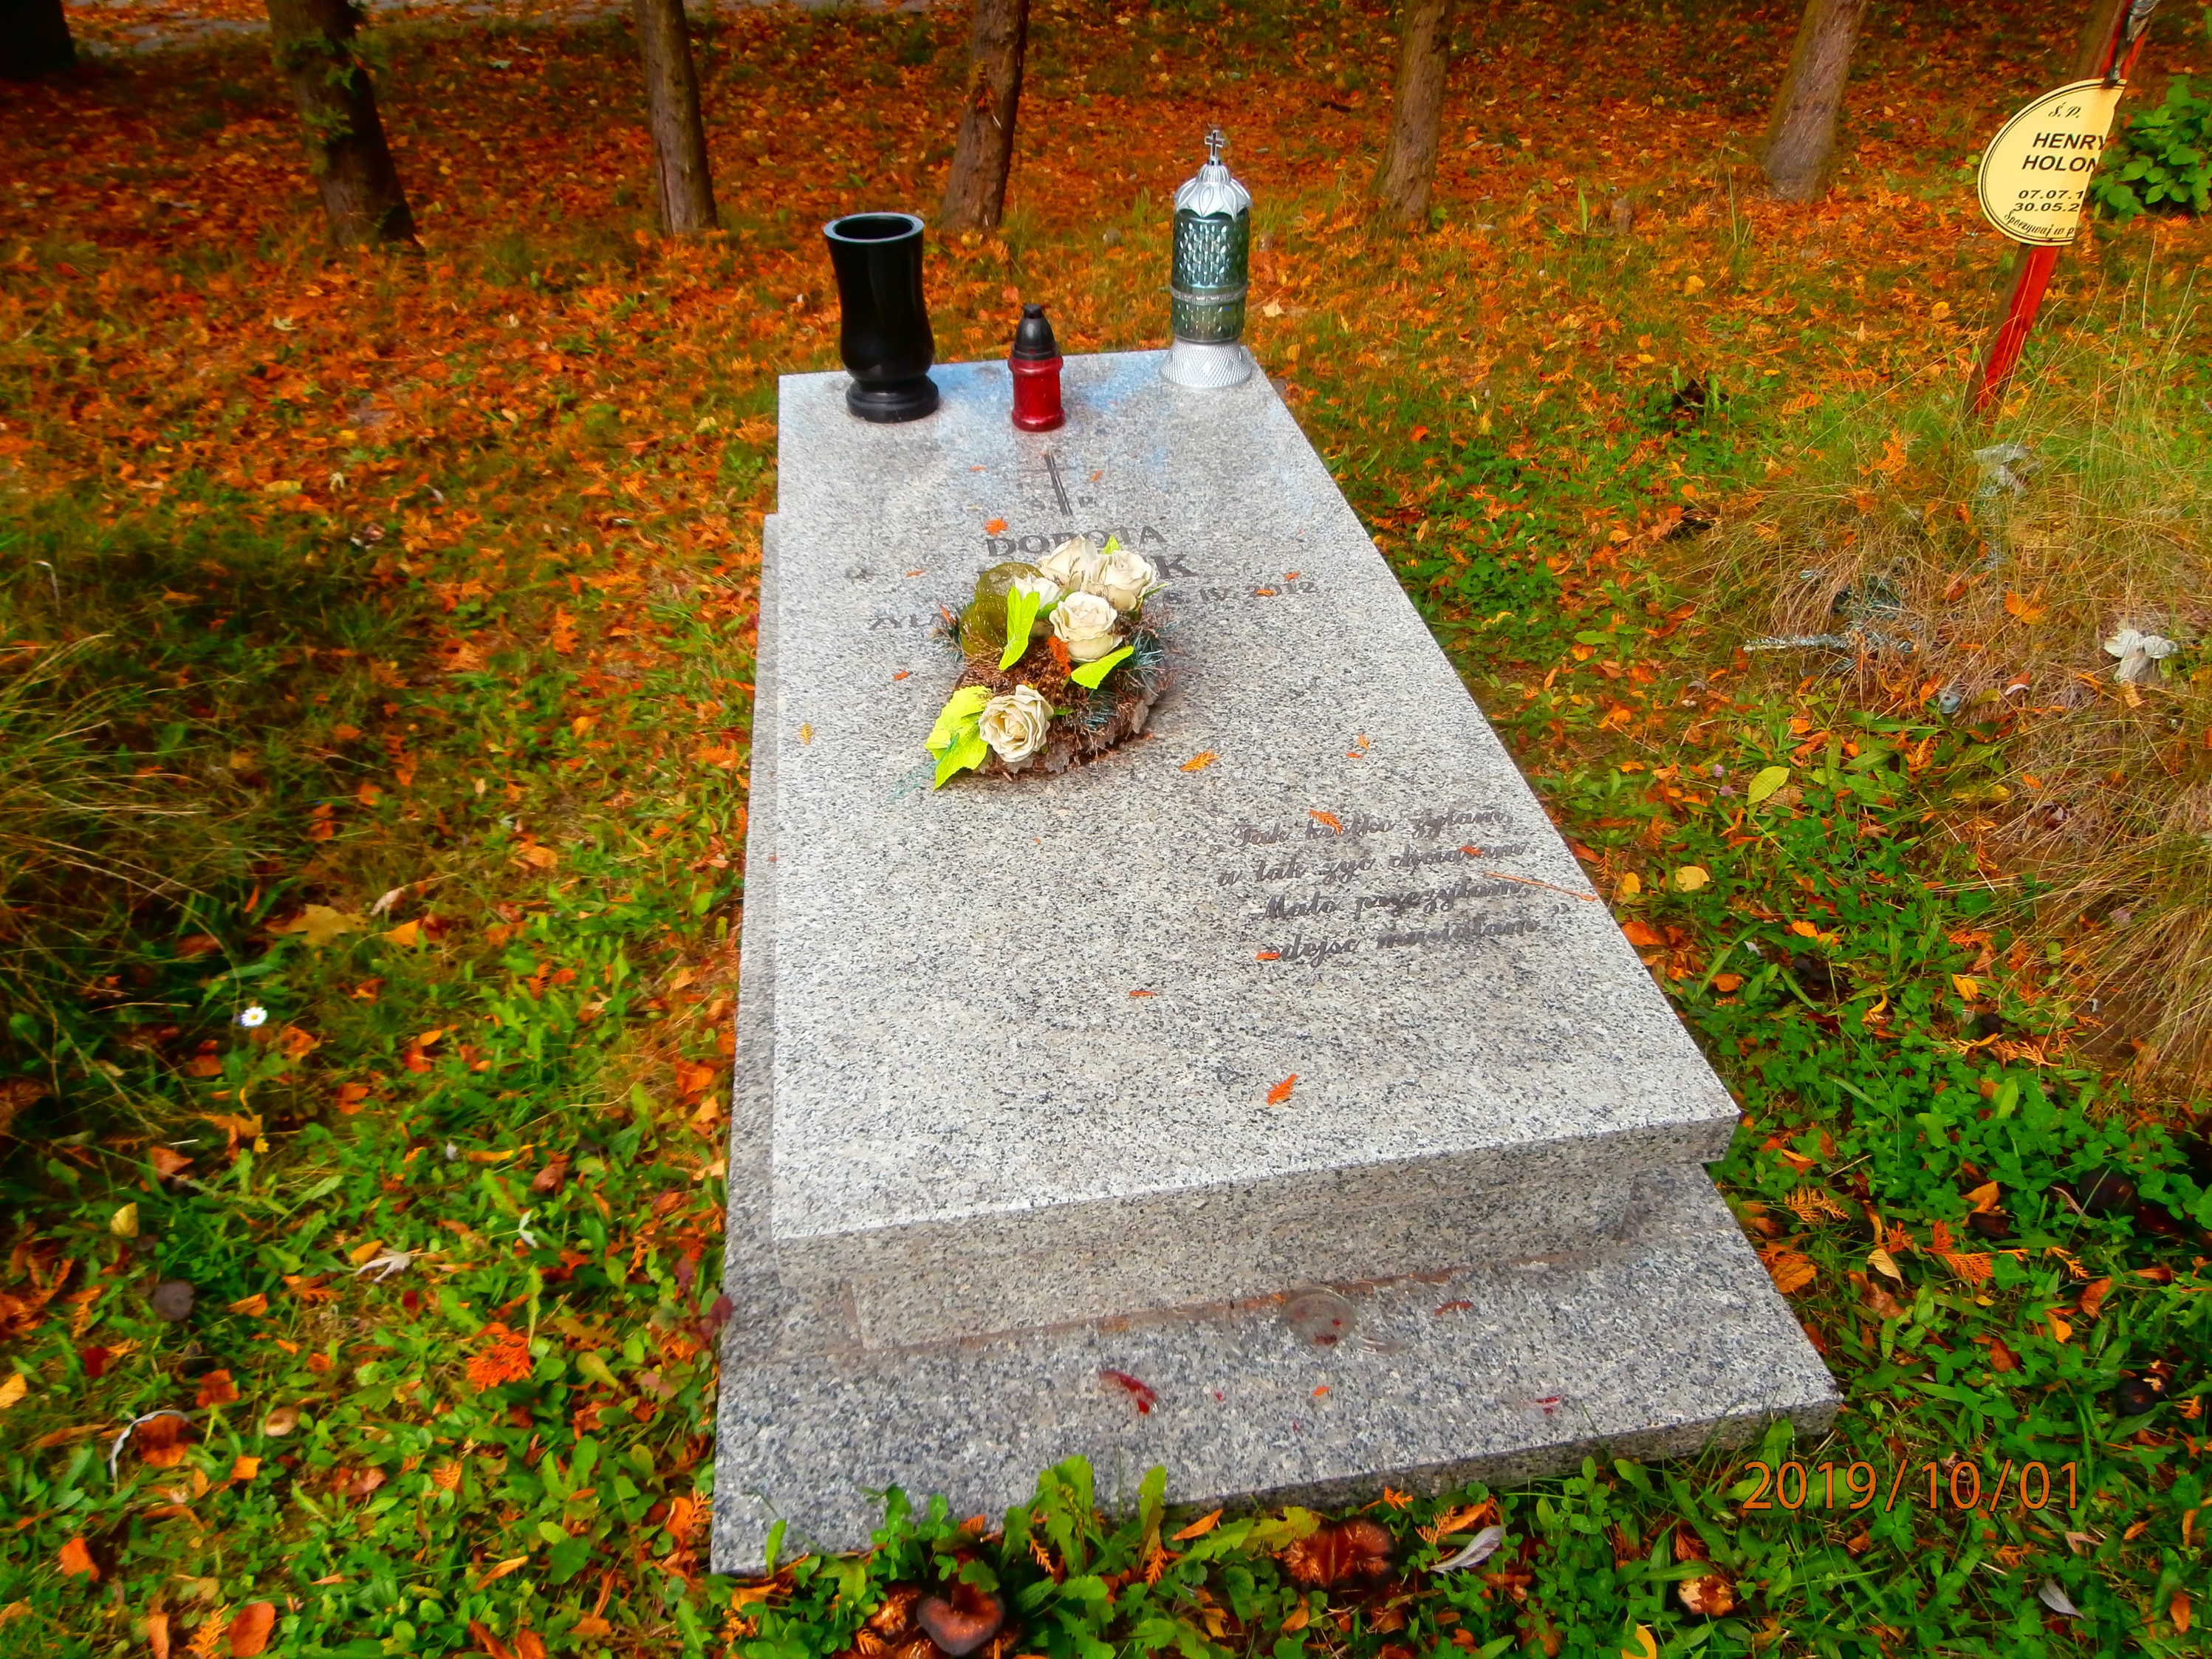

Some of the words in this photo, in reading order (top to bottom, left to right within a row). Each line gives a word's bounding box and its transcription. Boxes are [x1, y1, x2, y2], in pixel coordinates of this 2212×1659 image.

[2018, 190, 2084, 199] 07.07.1
[2013, 202, 2080, 212] 30.05.2
[2053, 227, 2065, 235] w
